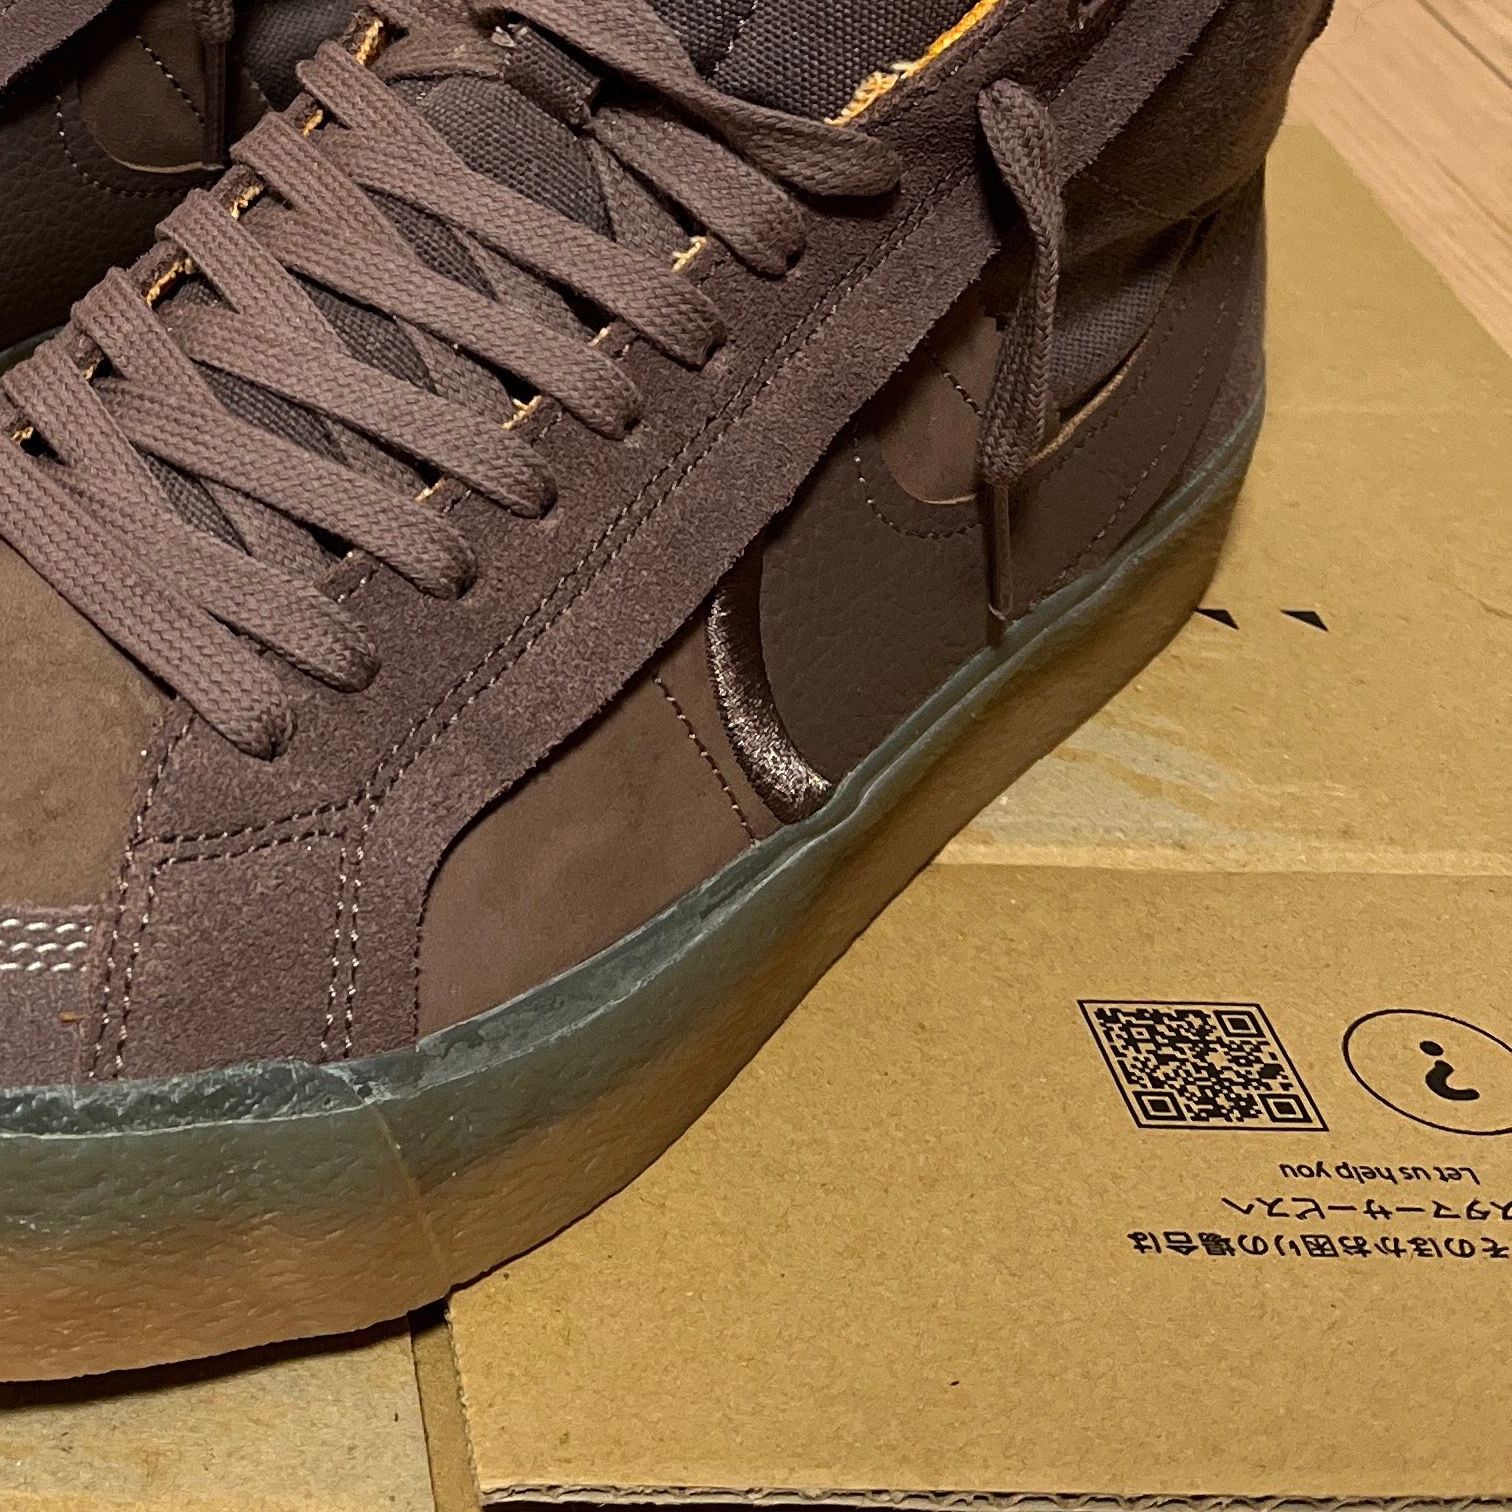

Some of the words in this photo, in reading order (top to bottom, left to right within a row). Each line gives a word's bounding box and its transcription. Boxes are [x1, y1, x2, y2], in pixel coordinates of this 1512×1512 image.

[1278, 1160, 1332, 1180] you
[1334, 1161, 1398, 1185] help
[1398, 1165, 1431, 1181] us
[1433, 1166, 1481, 1186] Let
[1126, 1231, 1509, 1258] そのほかお困りの場合は
